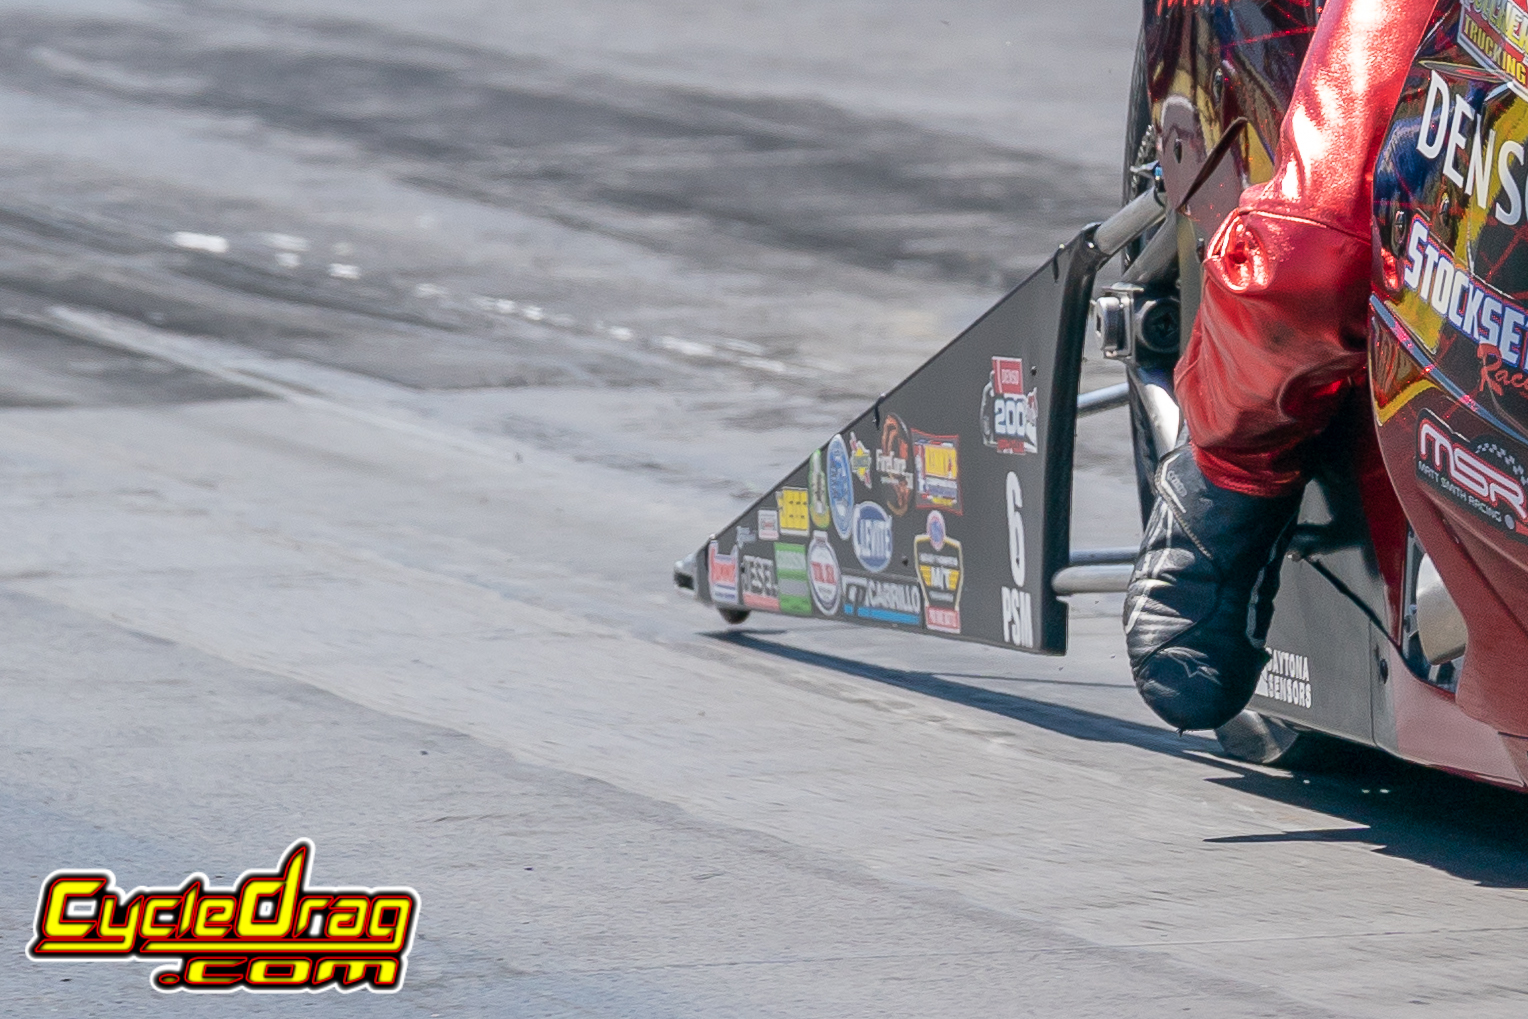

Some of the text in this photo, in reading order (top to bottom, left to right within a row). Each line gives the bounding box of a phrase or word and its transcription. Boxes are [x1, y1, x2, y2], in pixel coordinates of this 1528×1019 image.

[1463, 13, 1526, 85] TRUCKING
[1418, 417, 1528, 525] MSR
[1005, 470, 1026, 588] 6
[865, 578, 921, 614] CARRILLO
[1001, 585, 1034, 648] PSM
[1268, 673, 1312, 709] SENSORS
